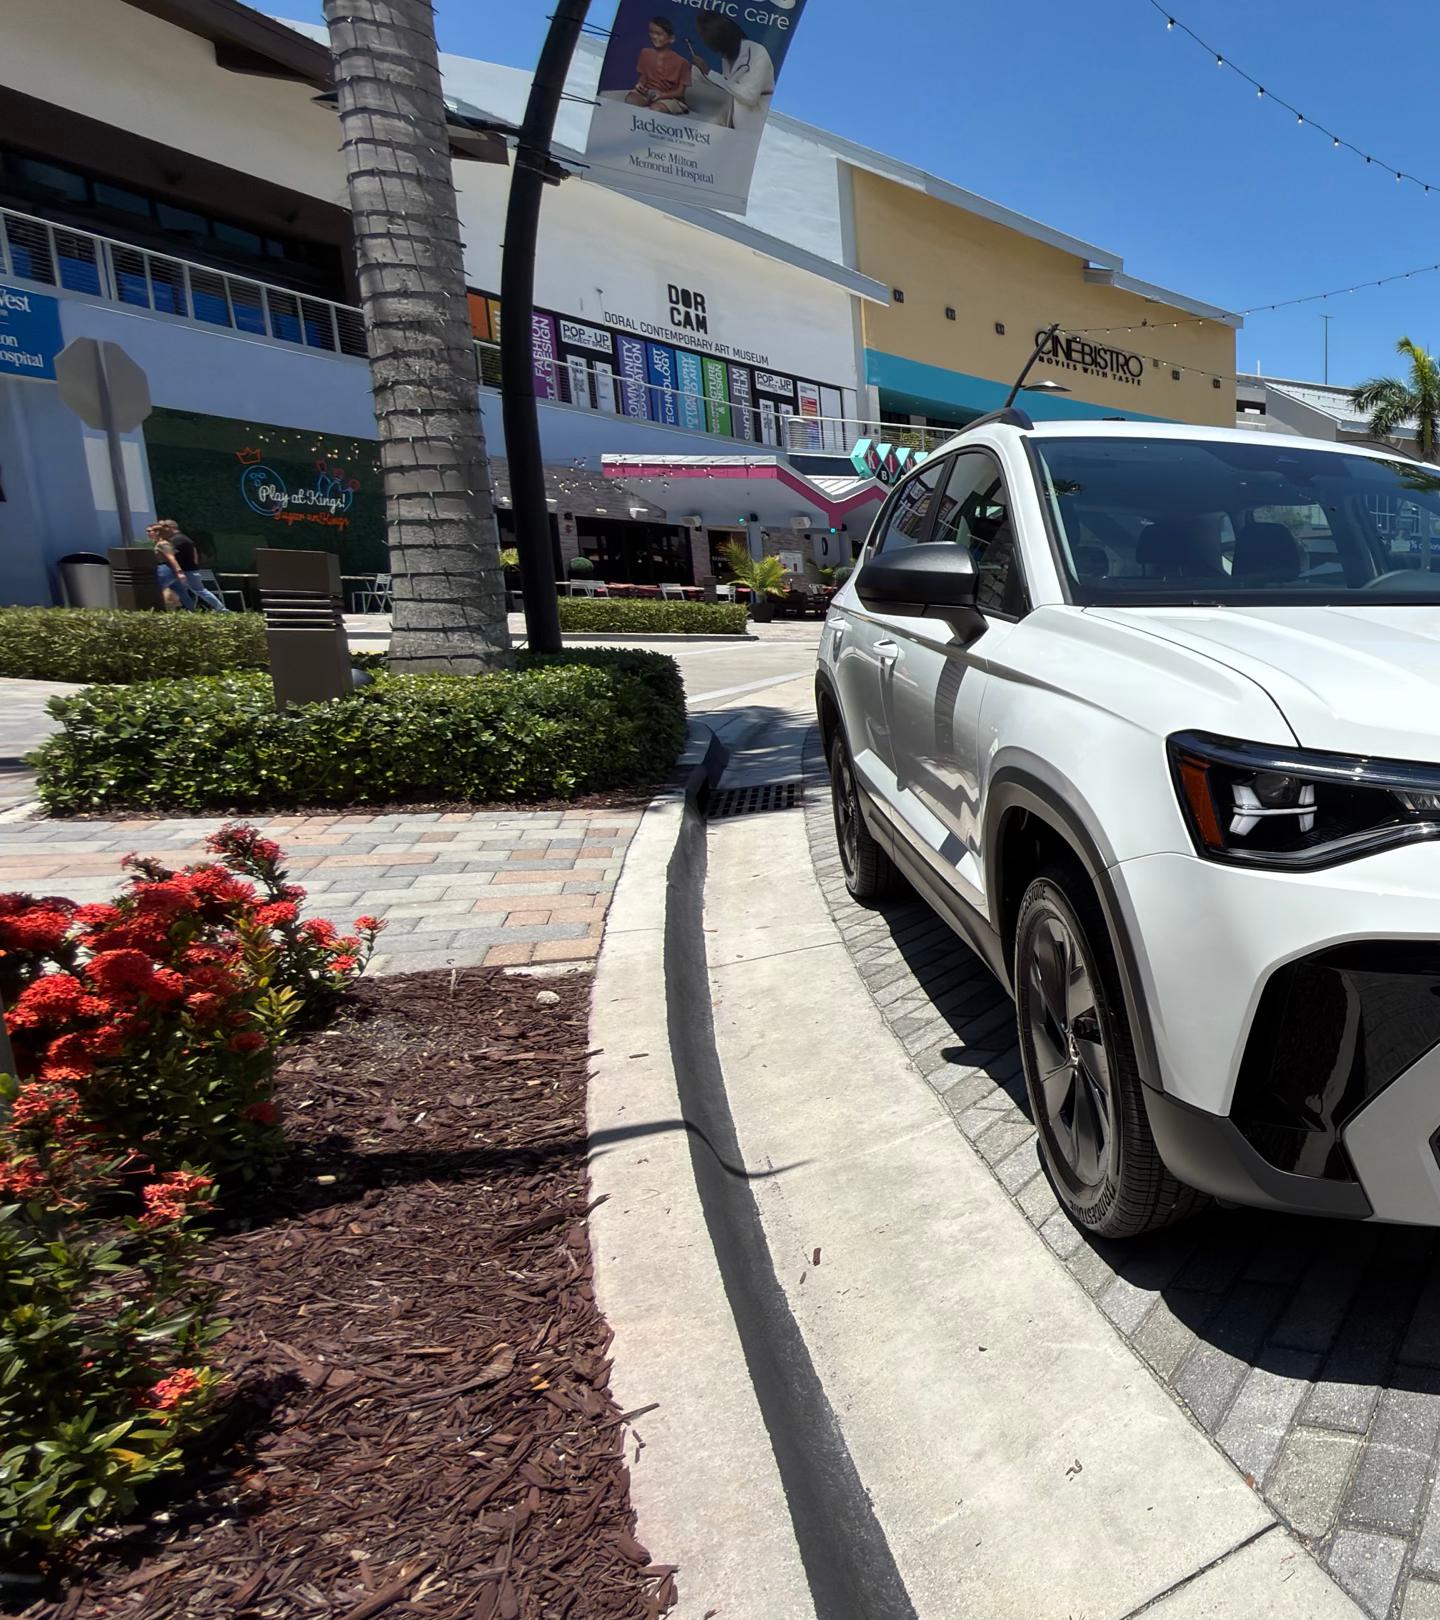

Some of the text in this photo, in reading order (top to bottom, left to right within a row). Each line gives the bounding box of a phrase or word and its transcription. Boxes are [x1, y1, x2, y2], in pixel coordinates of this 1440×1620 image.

[744, 7, 790, 30] care
[629, 154, 714, 184] Memorial Hospital
[646, 147, 698, 169] José Milton
[667, 284, 706, 314] DOR
[669, 306, 708, 335] CAM
[532, 315, 544, 377] FASHION
[604, 311, 769, 366] DORAL CONTEMPORARY ART MUSEUM
[0, 350, 44, 368] ospital
[653, 347, 663, 372] ART
[1039, 356, 1141, 386] MOVIES WITH TASTE
[660, 350, 675, 425] ECHNOLOGY
[732, 368, 741, 396] FILM
[740, 370, 749, 398] FILM
[259, 484, 346, 514] Play at Kings!
